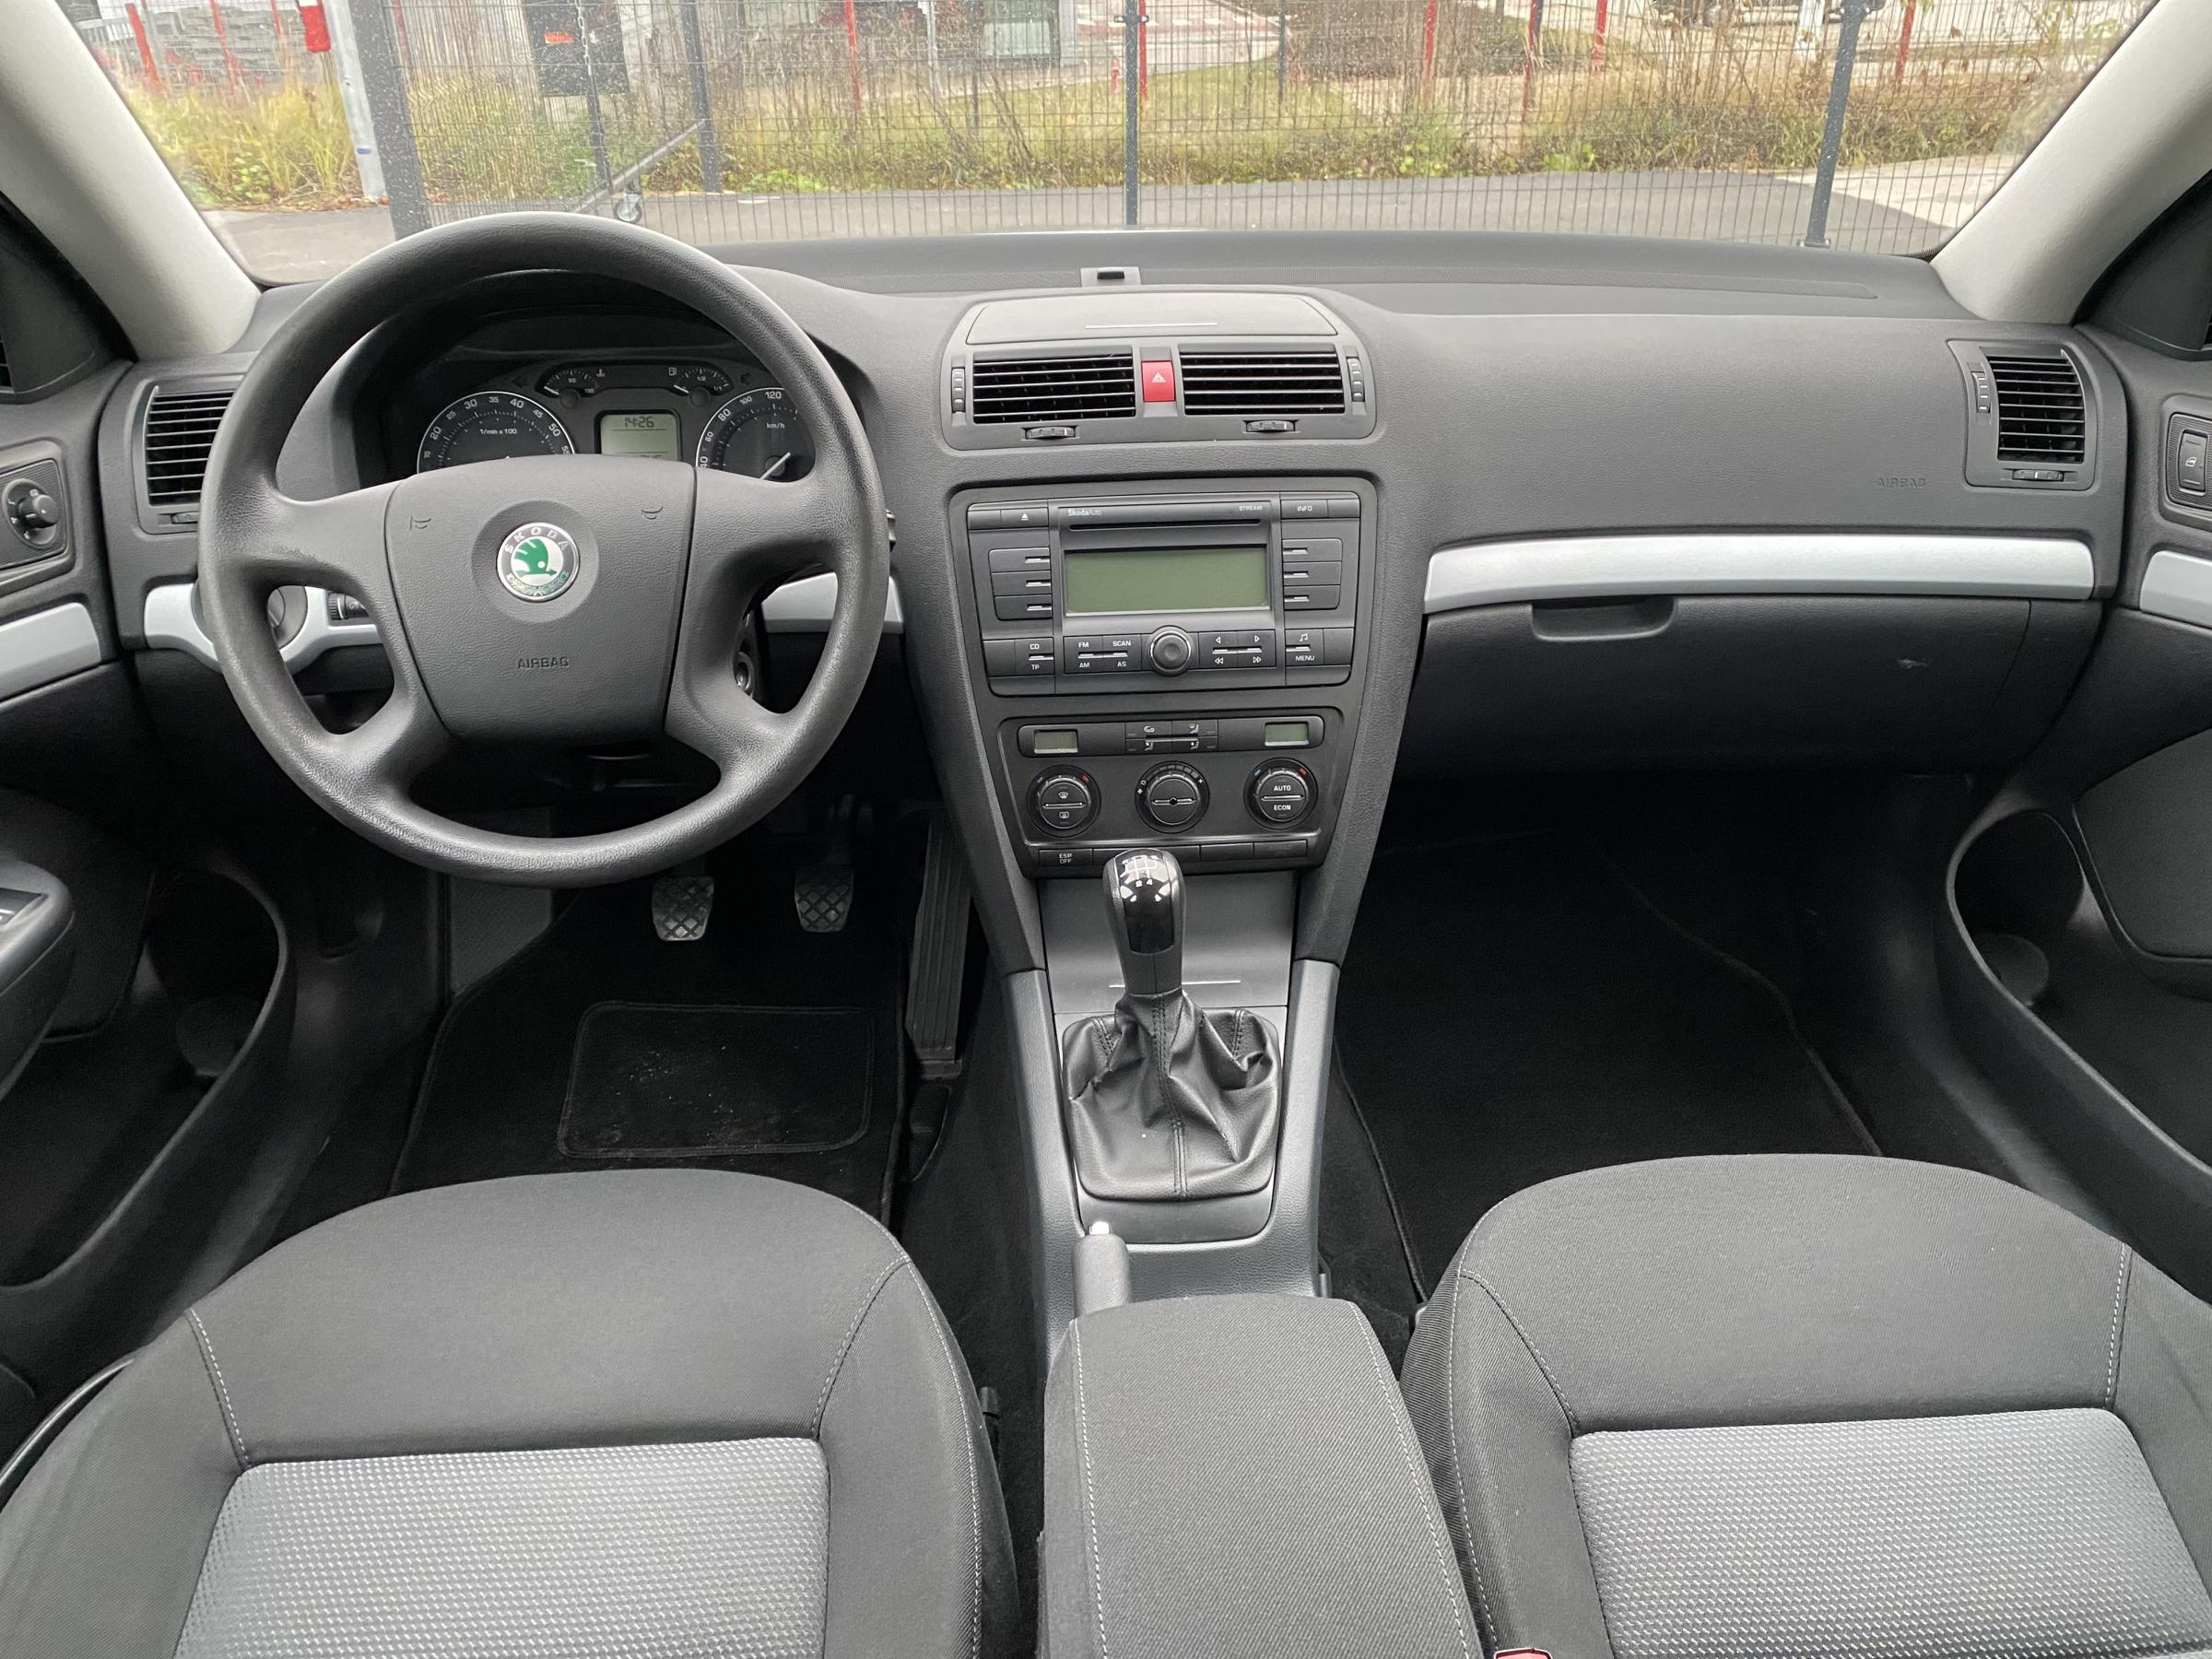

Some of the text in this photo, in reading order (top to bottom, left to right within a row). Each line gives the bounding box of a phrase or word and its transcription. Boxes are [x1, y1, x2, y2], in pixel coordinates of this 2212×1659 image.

[739, 395, 753, 406] 100
[764, 391, 782, 399] 120
[464, 398, 477, 409] 30
[510, 398, 524, 408] 40
[533, 408, 544, 418] 45
[718, 407, 731, 421] 80
[429, 426, 441, 441] 20
[548, 422, 561, 437] 50
[705, 431, 714, 441] 60
[517, 655, 570, 670] AIRBAG
